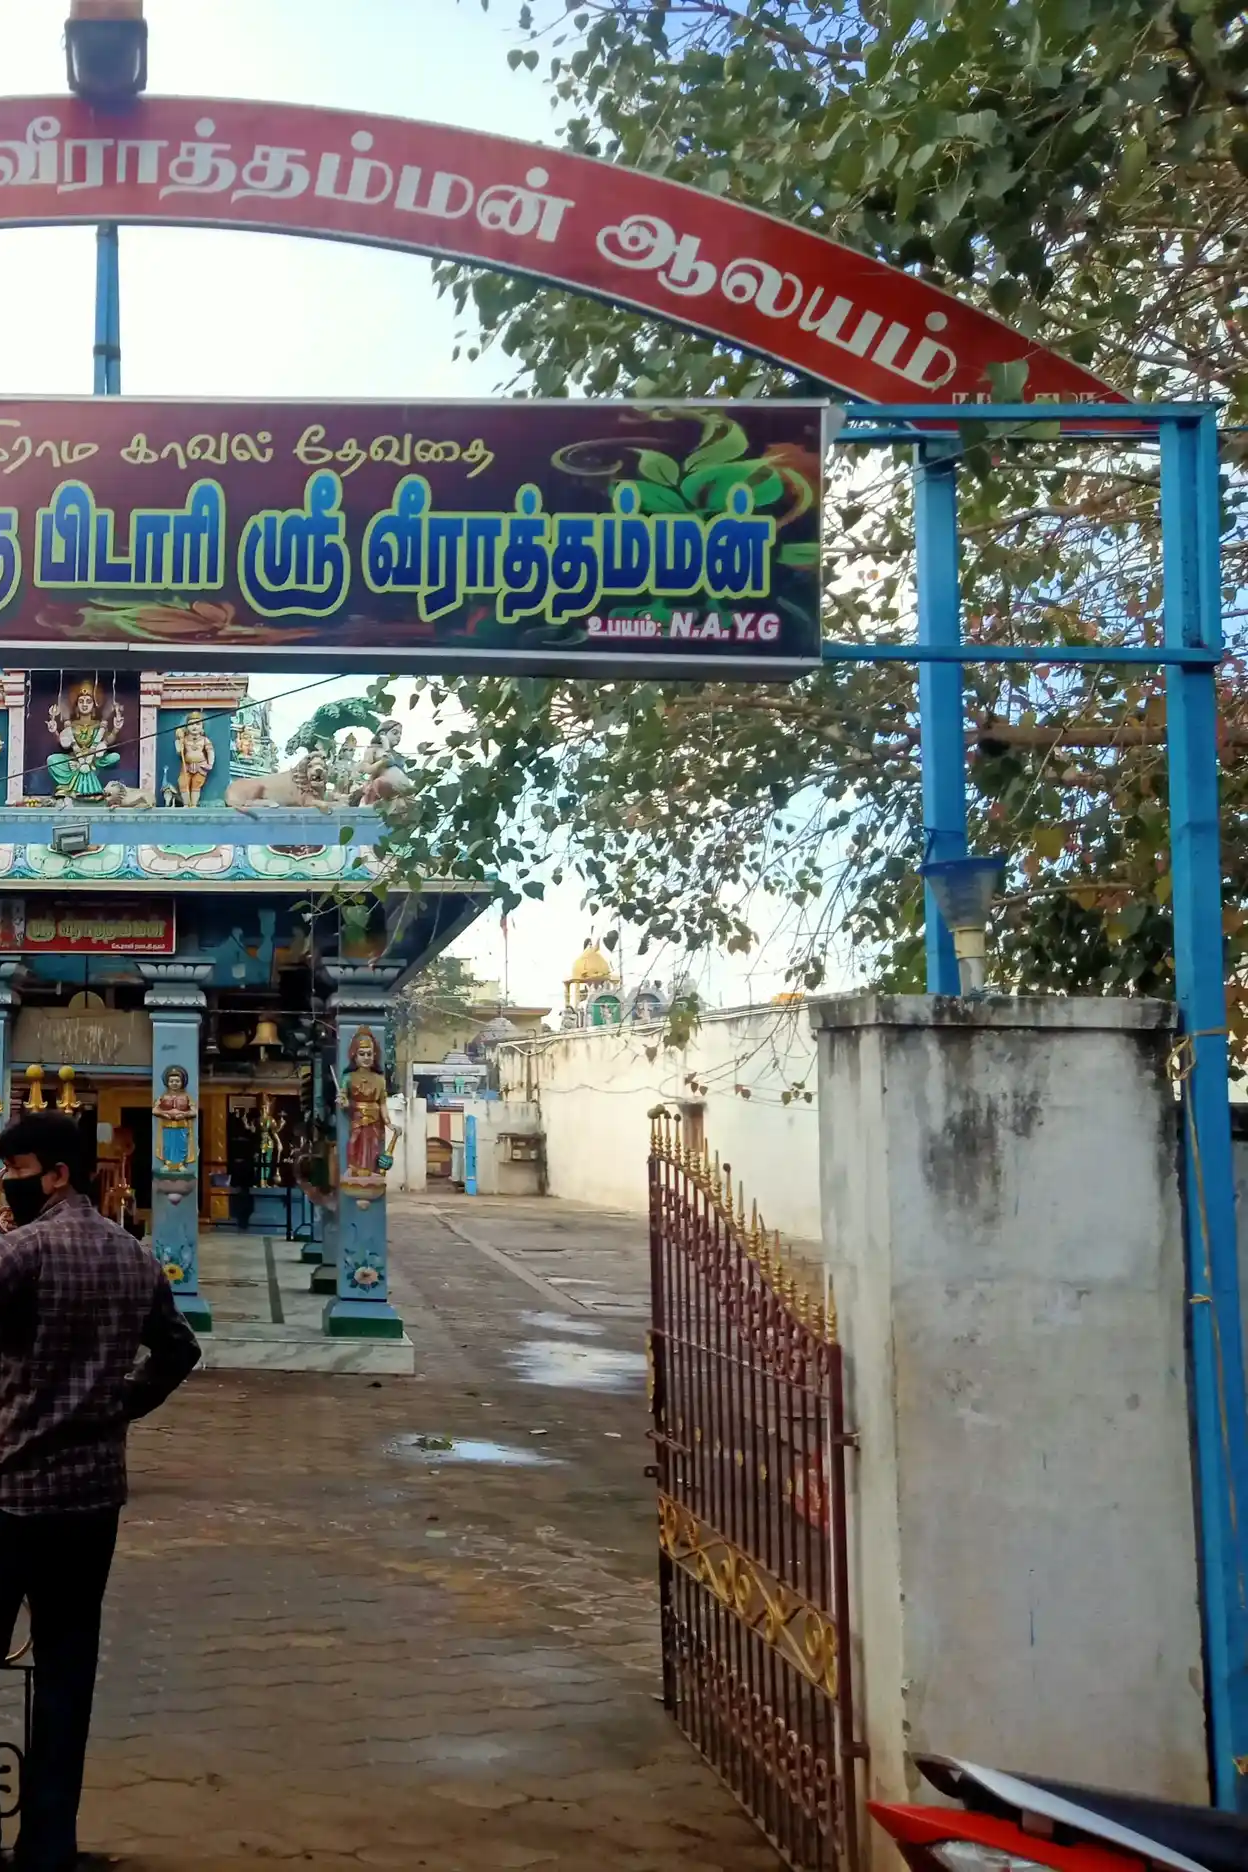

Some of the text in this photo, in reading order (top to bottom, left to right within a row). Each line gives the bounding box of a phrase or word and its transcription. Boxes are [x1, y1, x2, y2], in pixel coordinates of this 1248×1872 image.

[595, 214, 958, 391] ஆலயம்
[120, 431, 274, 470] காவல்
[292, 424, 495, 479] தேவதை
[33, 478, 226, 591] பிடாரி
[237, 469, 352, 618] ஸ்ரீ
[362, 473, 777, 624] வீராத்தம்மன்
[586, 611, 780, 640] உபயம்: N.A.Y.G
